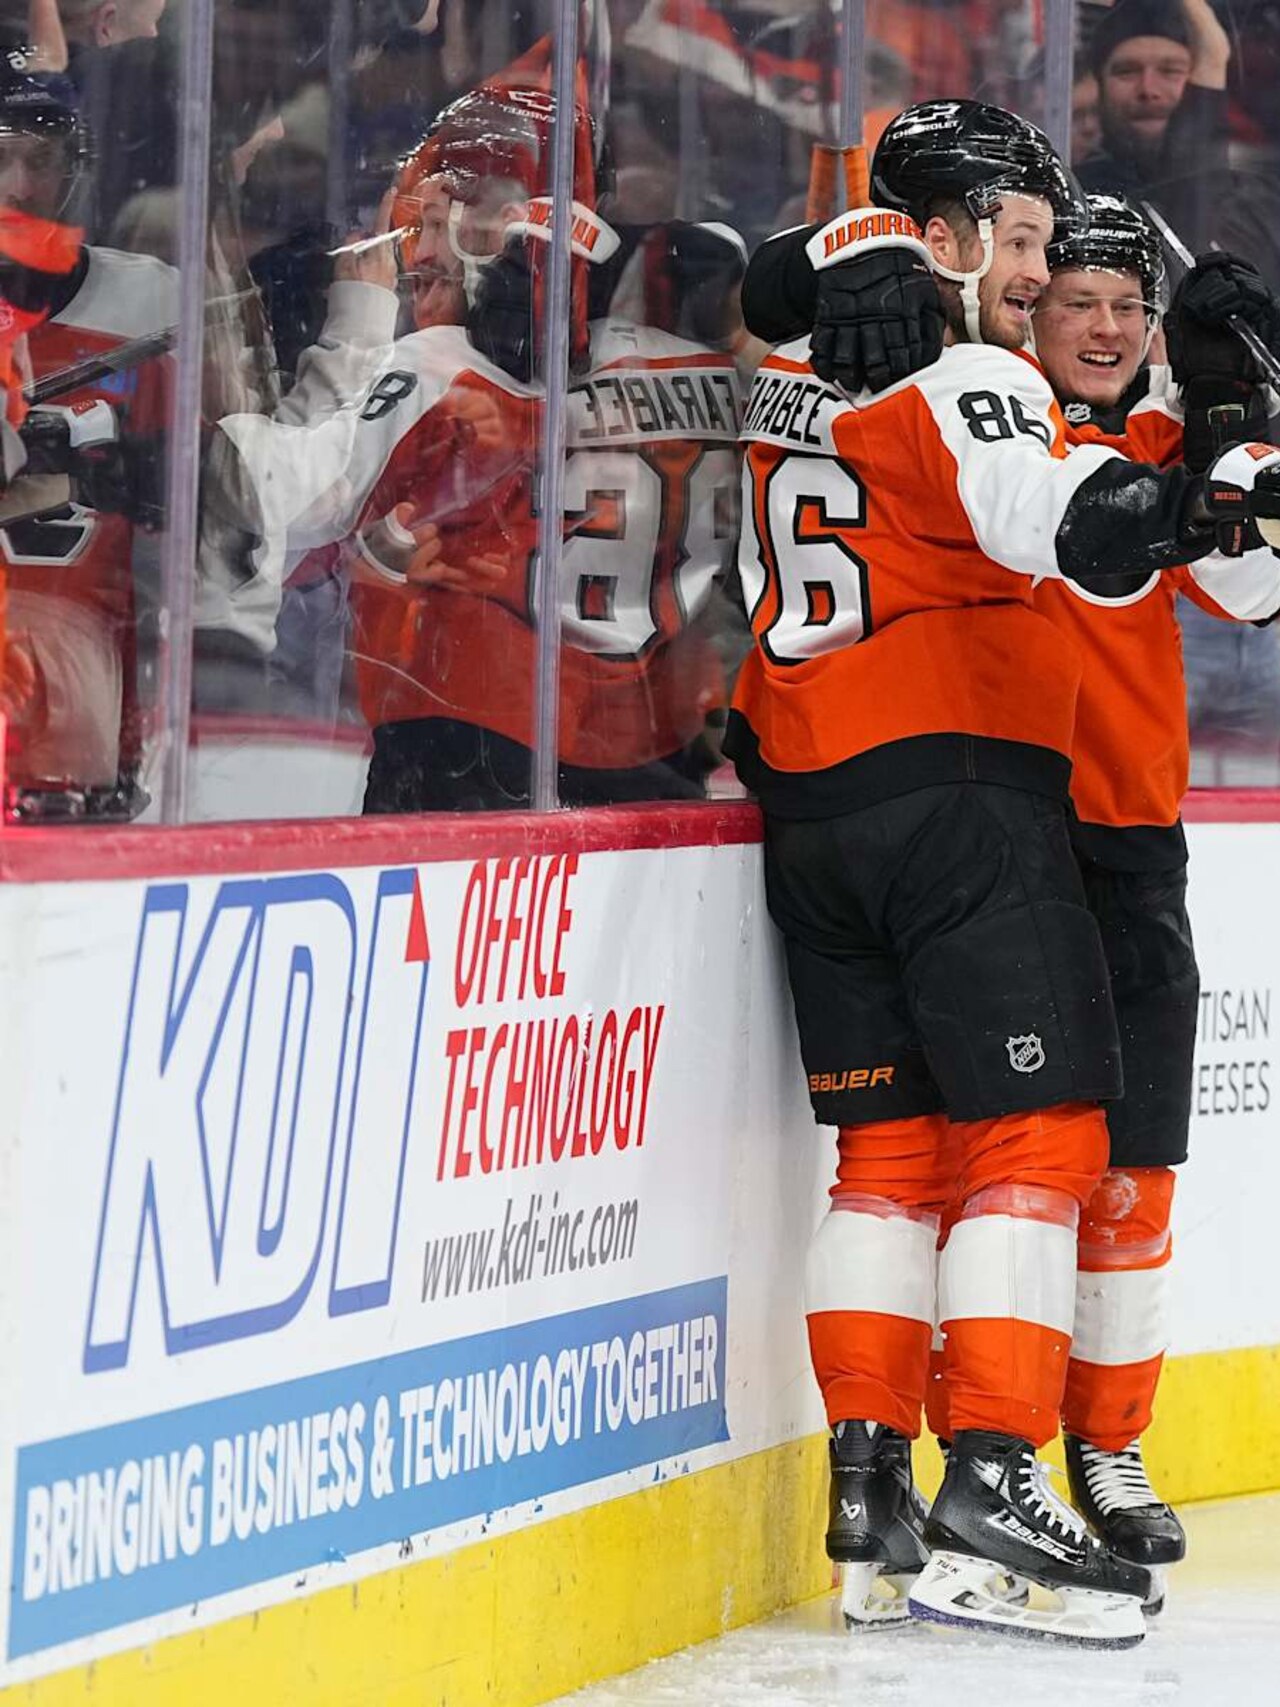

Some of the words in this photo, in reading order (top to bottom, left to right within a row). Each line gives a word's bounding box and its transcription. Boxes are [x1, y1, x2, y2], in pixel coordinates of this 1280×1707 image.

[957, 390, 1052, 453] 86
[455, 853, 579, 1008] OFFICE
[1200, 987, 1271, 1042] TISAN
[82, 866, 431, 1375] KDI
[436, 1006, 665, 1182] TECHNOLOGY
[1198, 1060, 1271, 1115] EESES
[421, 1190, 639, 1303] www.kdi-inc.com
[23, 1444, 205, 1601] BRINGING
[210, 1402, 366, 1547] BUSINESS
[371, 1394, 395, 1499] &
[400, 1345, 590, 1490] TECHNOLOGY
[591, 1314, 718, 1434] TOGETHER
